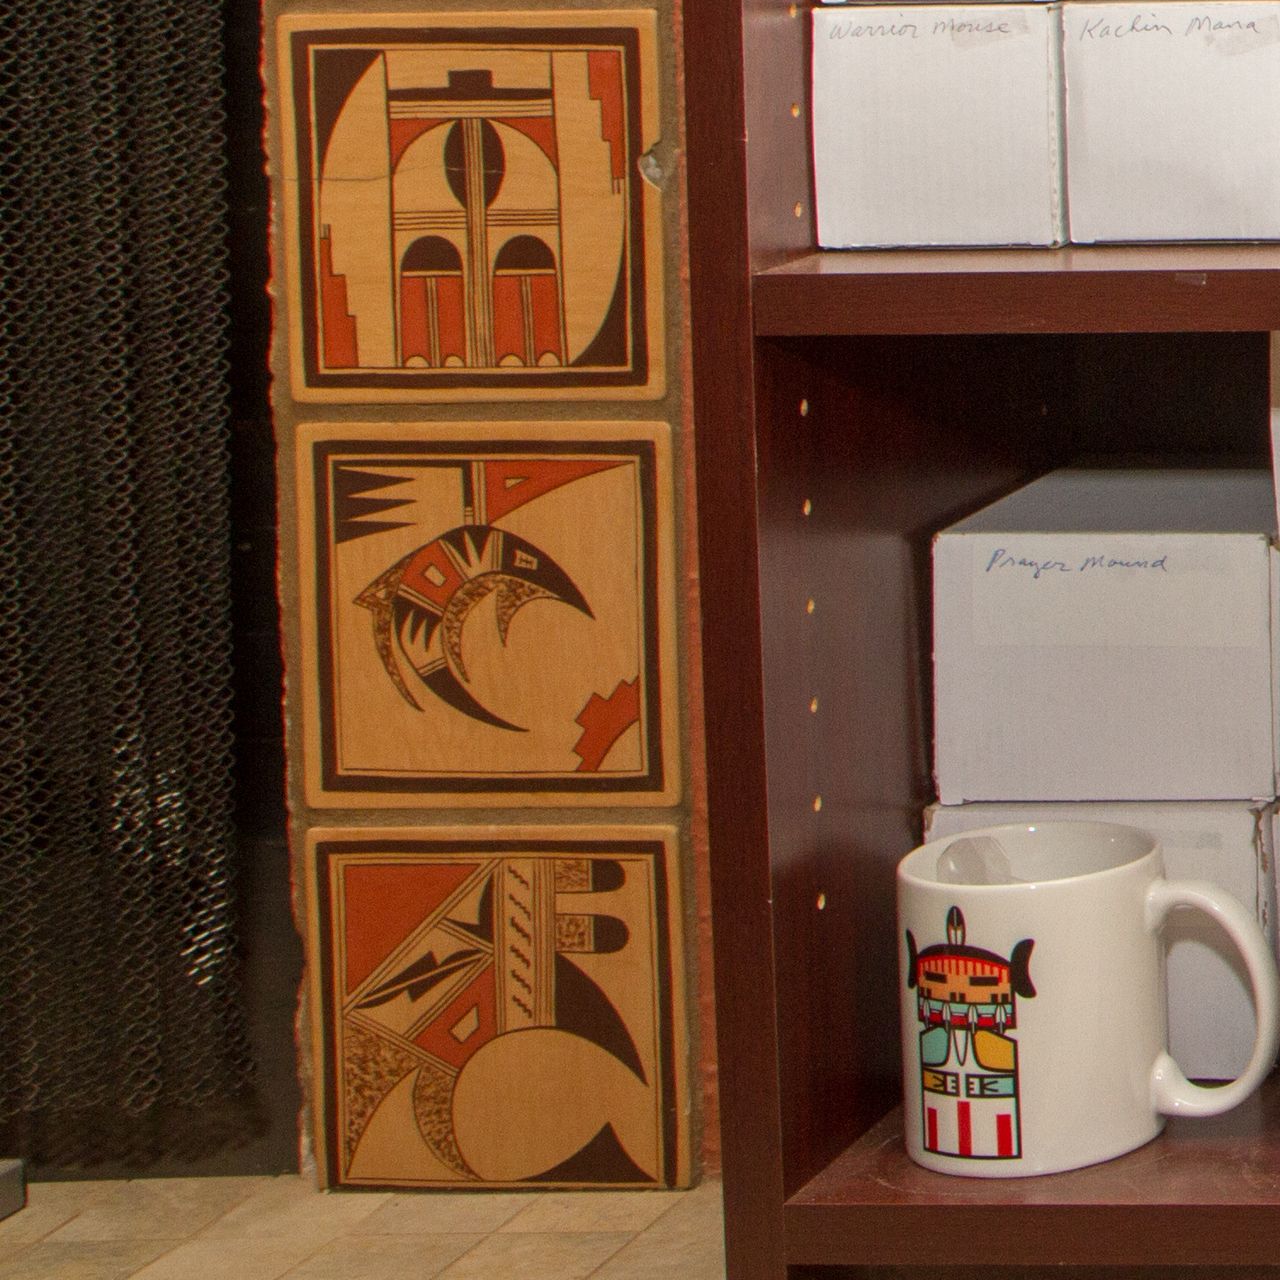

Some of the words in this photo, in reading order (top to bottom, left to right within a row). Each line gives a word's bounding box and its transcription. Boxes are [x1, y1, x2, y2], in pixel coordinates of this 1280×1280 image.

[829, 14, 918, 40] Warrior
[932, 17, 1011, 42] Mouse
[1079, 13, 1173, 41] Kachin
[1185, 15, 1262, 37] Mana
[986, 548, 1072, 577] Prayer
[1079, 553, 1168, 574] Mound
